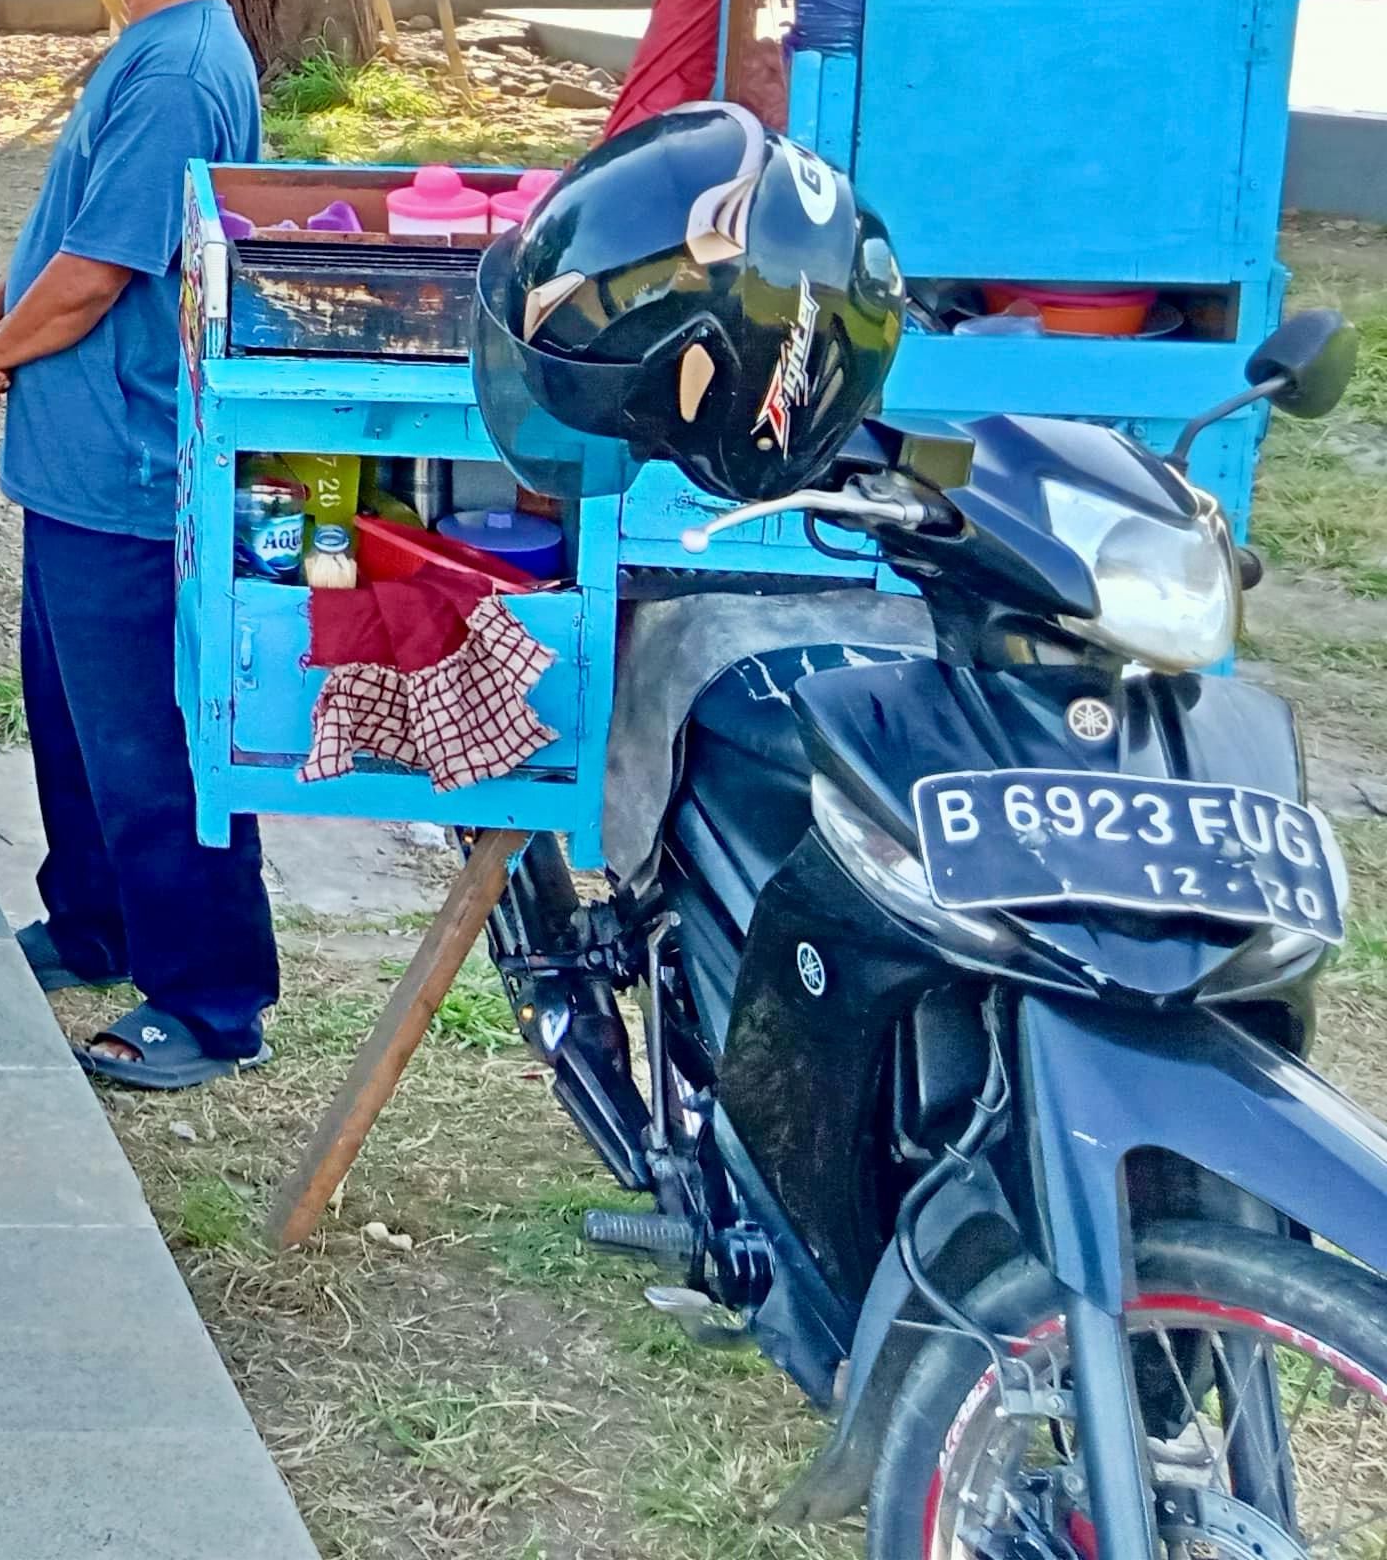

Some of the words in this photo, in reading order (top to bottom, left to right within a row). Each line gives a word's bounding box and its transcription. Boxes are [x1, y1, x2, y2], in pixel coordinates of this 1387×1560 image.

[935, 788, 981, 843] B
[1003, 784, 1176, 846] 6923
[1188, 797, 1316, 868] FUG
